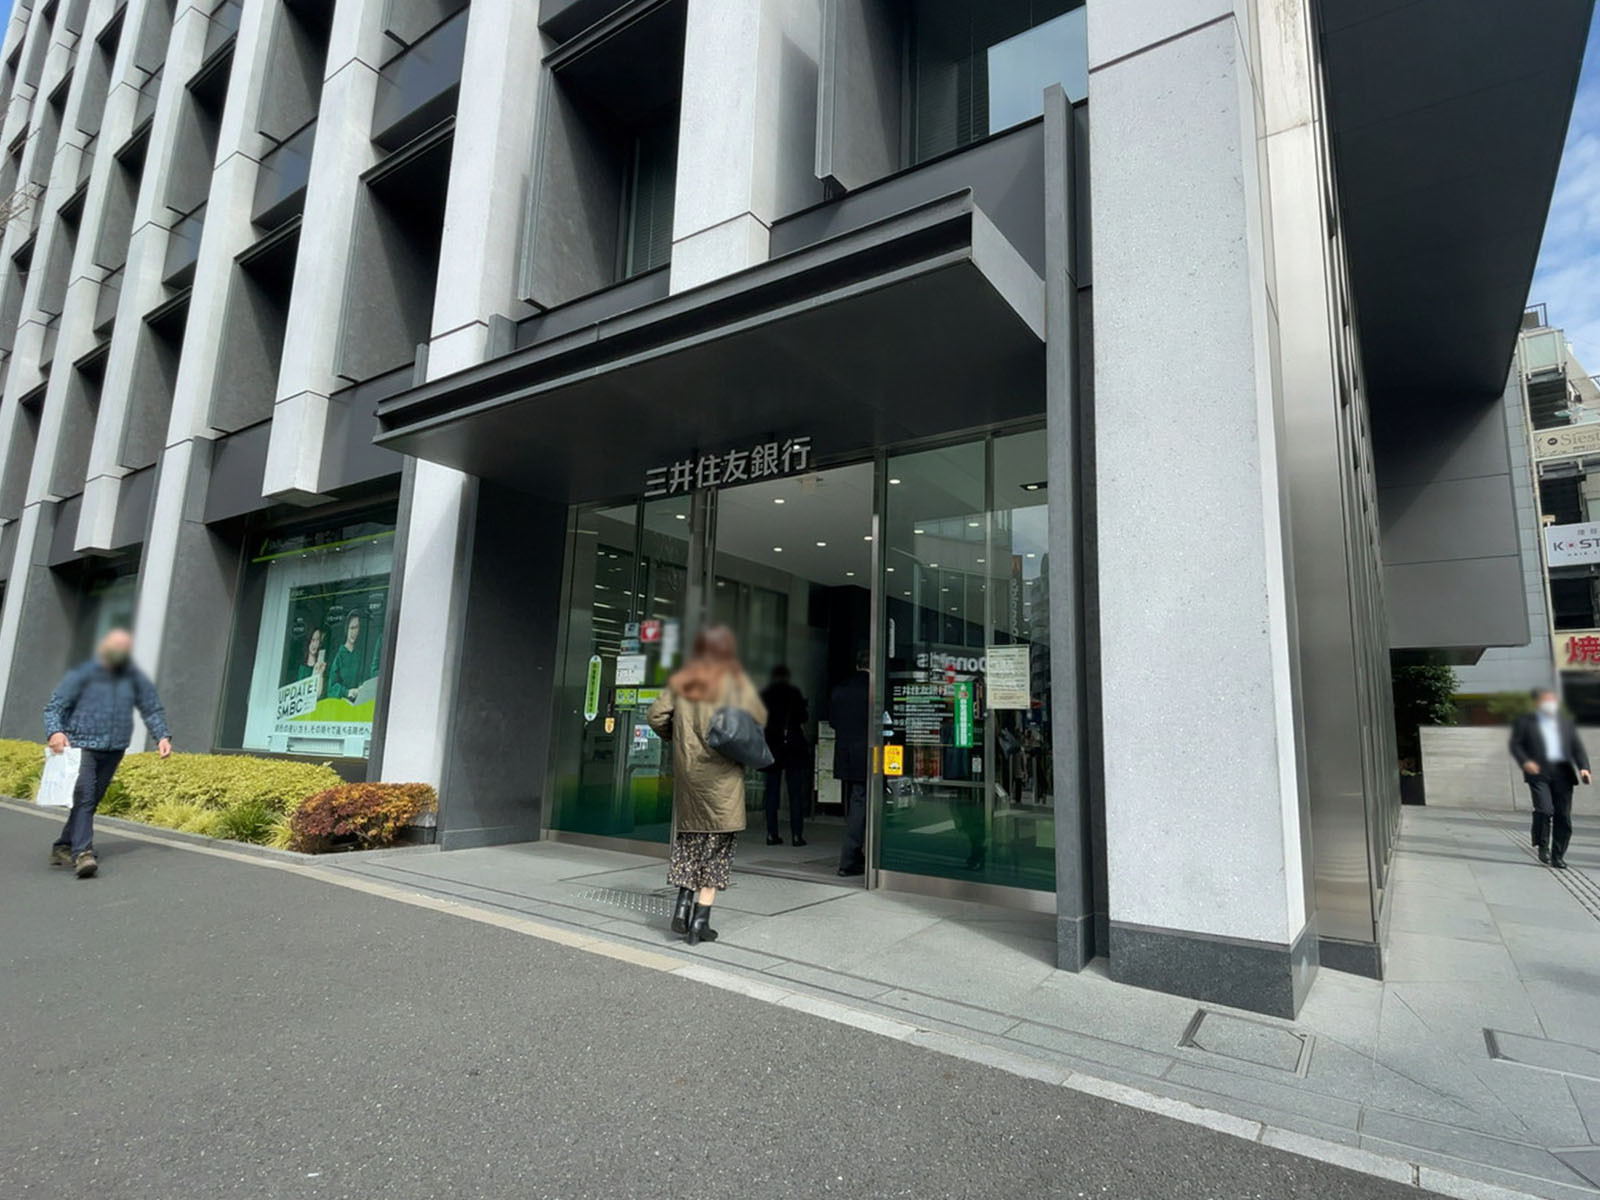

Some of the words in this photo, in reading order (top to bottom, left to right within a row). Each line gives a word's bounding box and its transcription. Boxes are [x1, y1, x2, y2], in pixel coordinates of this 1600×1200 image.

[644, 436, 811, 497] 三井住友銀行
[279, 676, 318, 704] UPDATE!
[277, 699, 303, 720] SMBC
